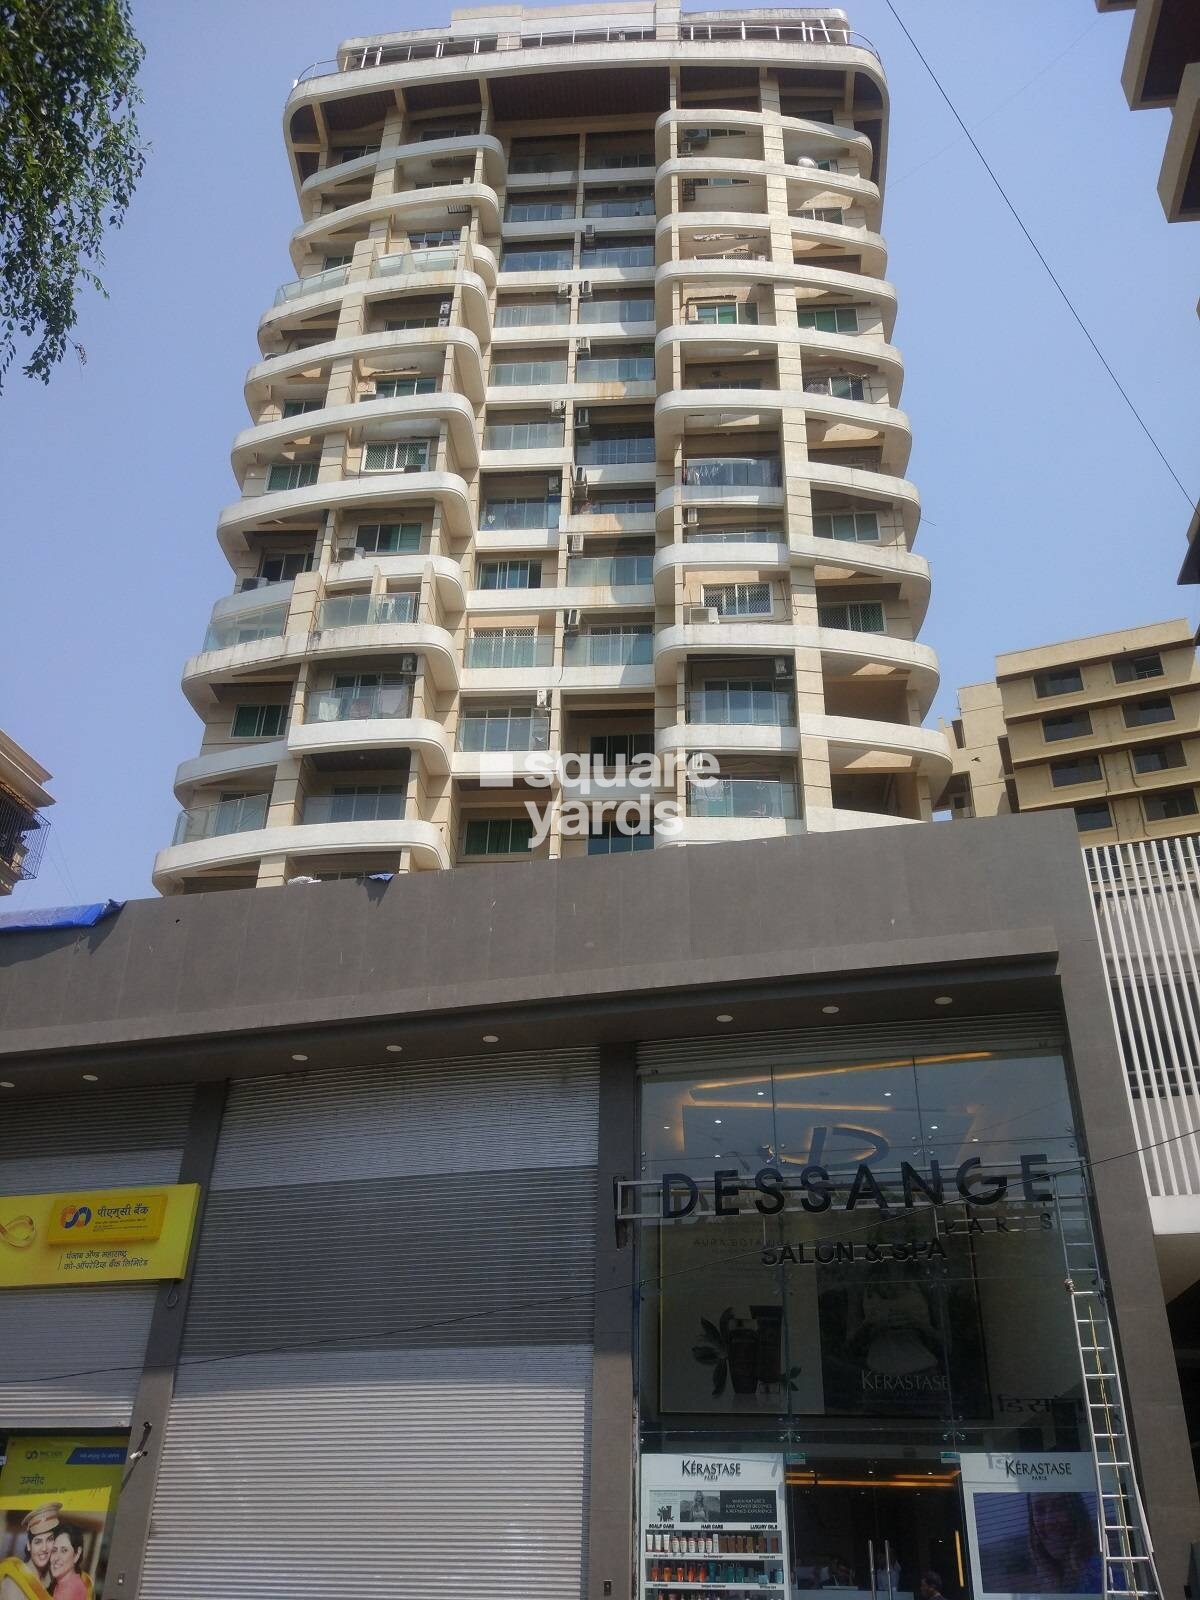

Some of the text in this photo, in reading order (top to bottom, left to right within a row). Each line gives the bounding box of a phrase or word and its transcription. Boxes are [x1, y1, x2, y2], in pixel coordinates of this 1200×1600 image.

[662, 1153, 1053, 1218] DESSANGE
[761, 1240, 855, 1266] SALON
[892, 1237, 947, 1262] SPA
[682, 1459, 741, 1477] KÉRASTASE
[1005, 1457, 1072, 1477] KÉRASTASE
